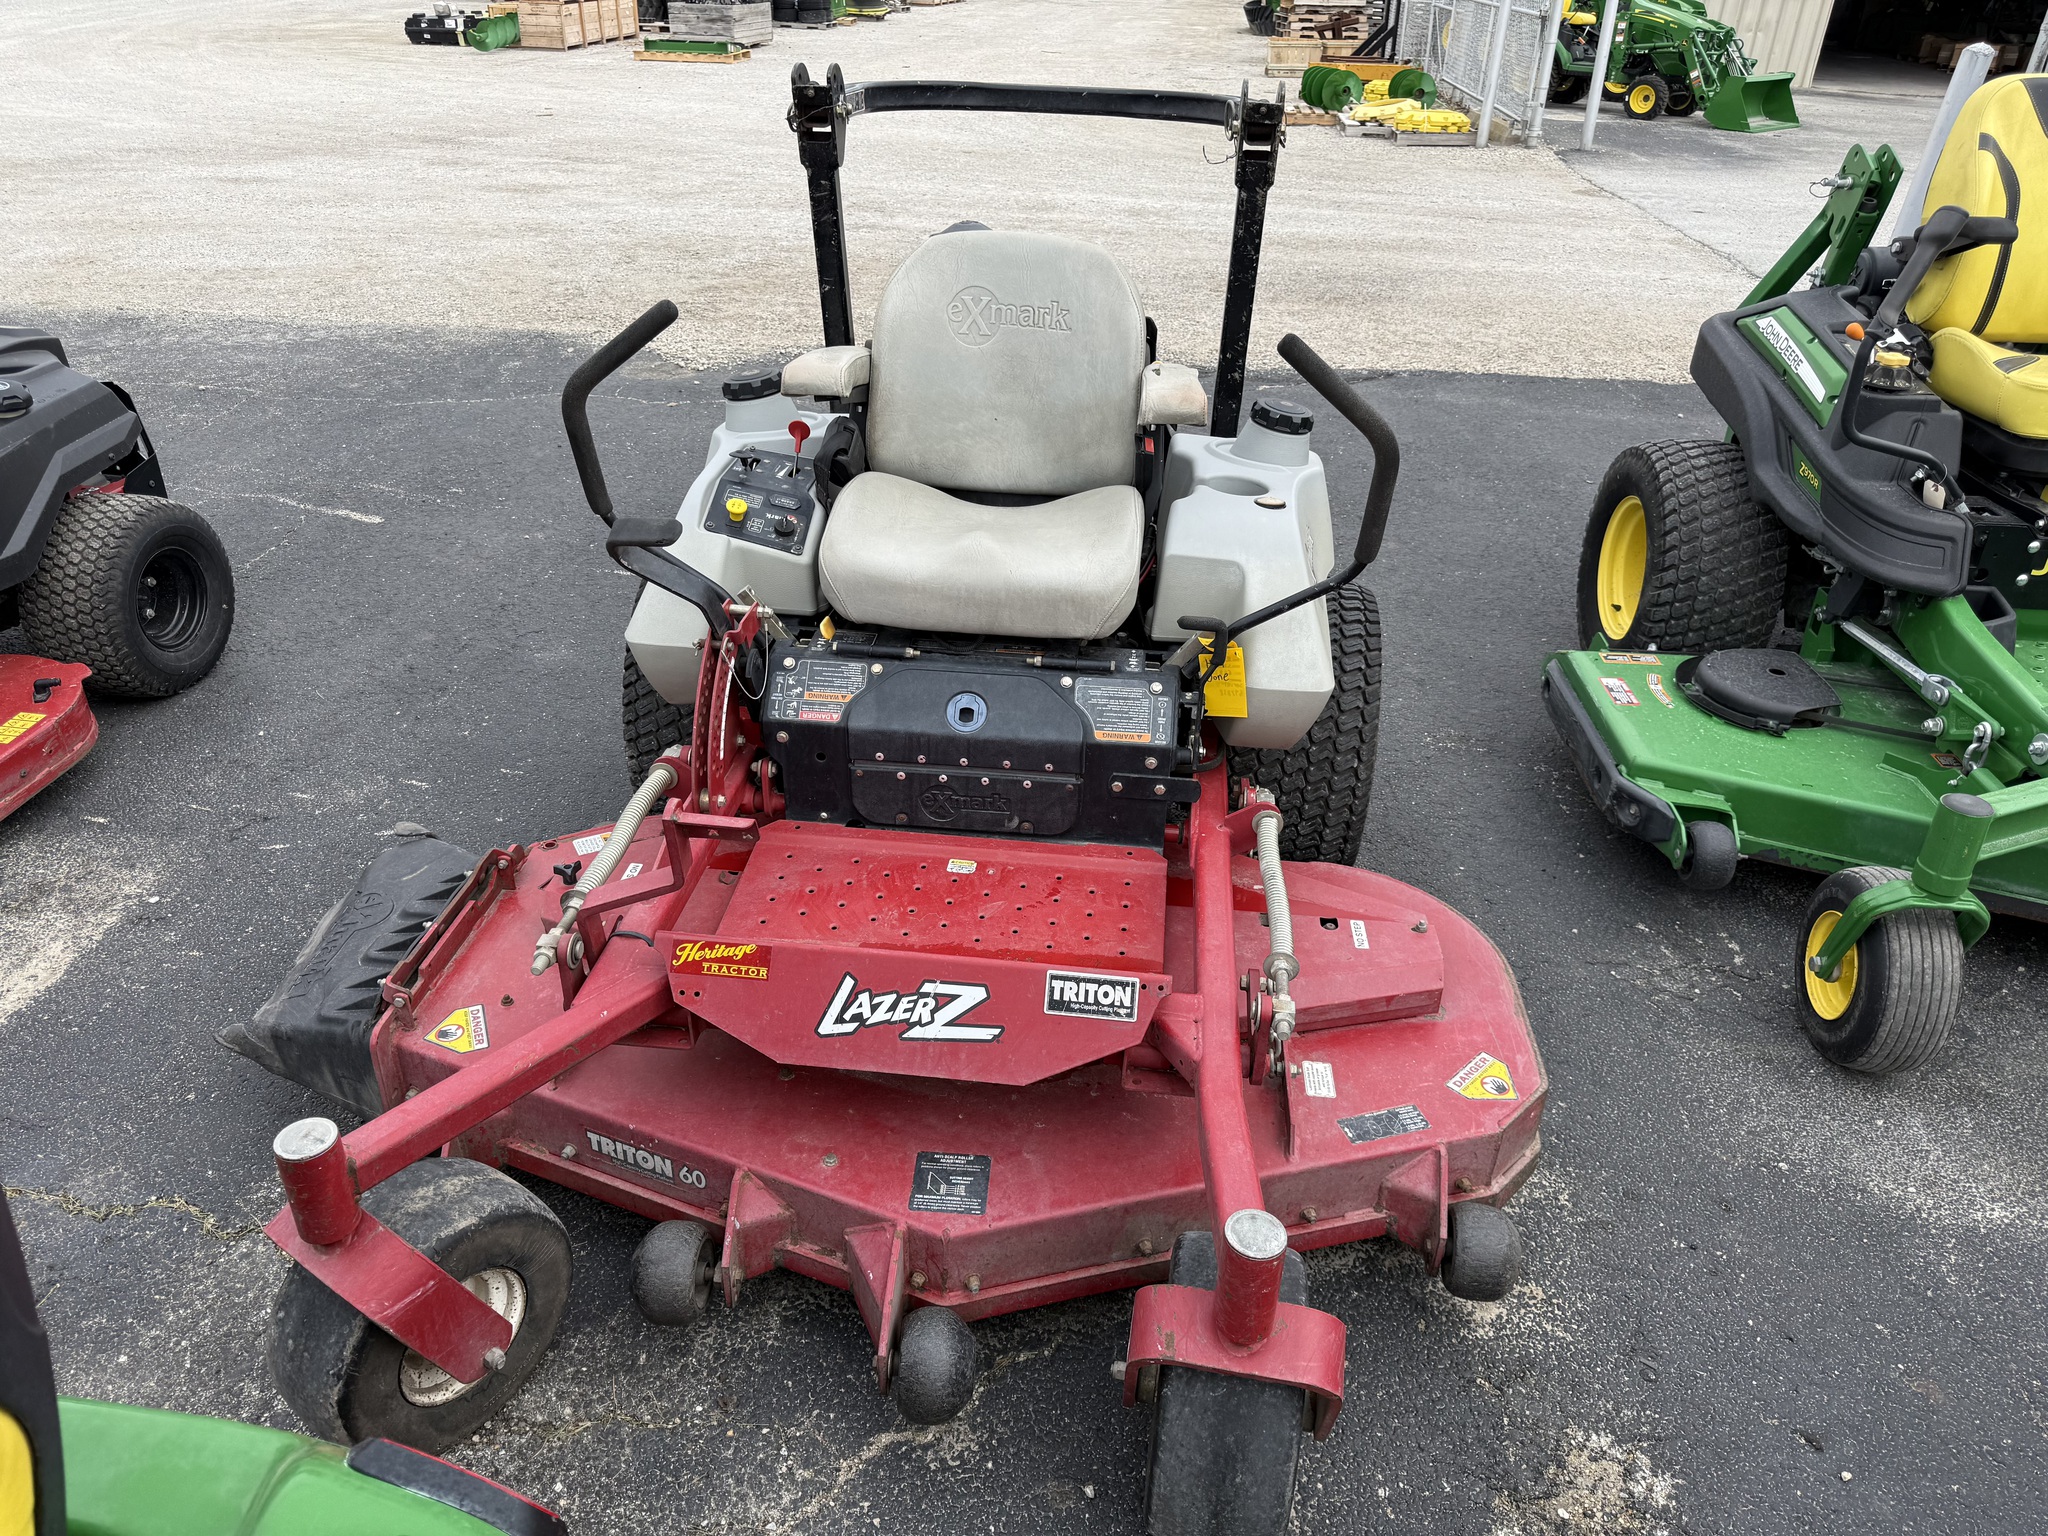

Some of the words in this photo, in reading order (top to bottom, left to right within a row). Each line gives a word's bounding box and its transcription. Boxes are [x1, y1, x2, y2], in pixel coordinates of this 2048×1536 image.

[946, 294, 1071, 336] eXmark
[1761, 320, 1782, 347] JOHN
[1779, 336, 1804, 371] DEERE
[1799, 461, 1819, 490] Z970R
[1102, 732, 1135, 740] WARNING
[921, 790, 1010, 814] eXmark
[630, 865, 640, 873] NO
[1353, 922, 1363, 937] STEP
[1356, 938, 1365, 947] NO
[672, 941, 757, 966] Heritage
[702, 964, 768, 978] TRACTOR
[1051, 980, 1131, 1007] TRITON
[470, 1009, 484, 1045] DANGER
[1453, 1057, 1490, 1088] DANGER
[586, 1131, 673, 1178] TRITON
[679, 1166, 706, 1189] 60
